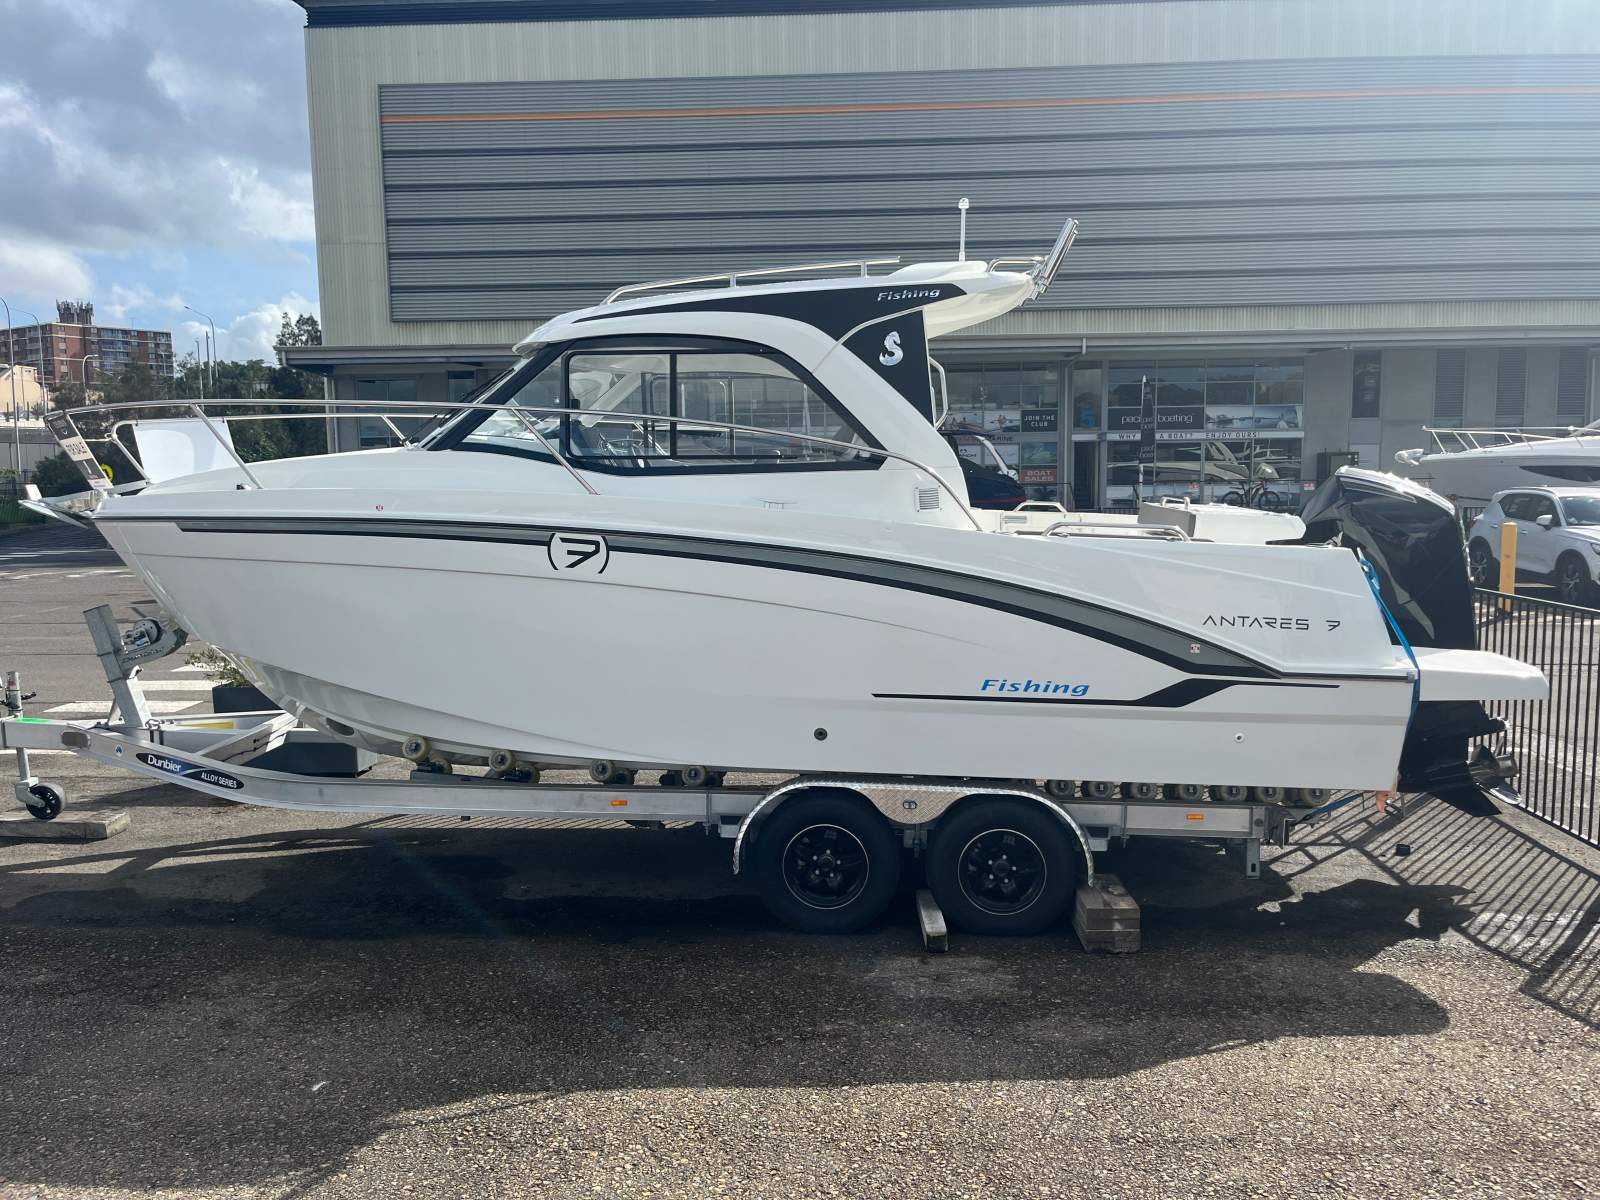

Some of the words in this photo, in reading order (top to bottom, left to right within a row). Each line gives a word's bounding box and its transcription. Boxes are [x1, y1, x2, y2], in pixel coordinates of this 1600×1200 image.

[877, 289, 940, 301] Fishing
[1157, 414, 1193, 423] boating
[1202, 615, 1310, 631] ANTARES
[1325, 619, 1341, 632] 7
[980, 679, 1090, 697] Fishing
[148, 755, 181, 771] Dunbier
[201, 771, 219, 784] ALLOY
[218, 776, 238, 789] SERIES
